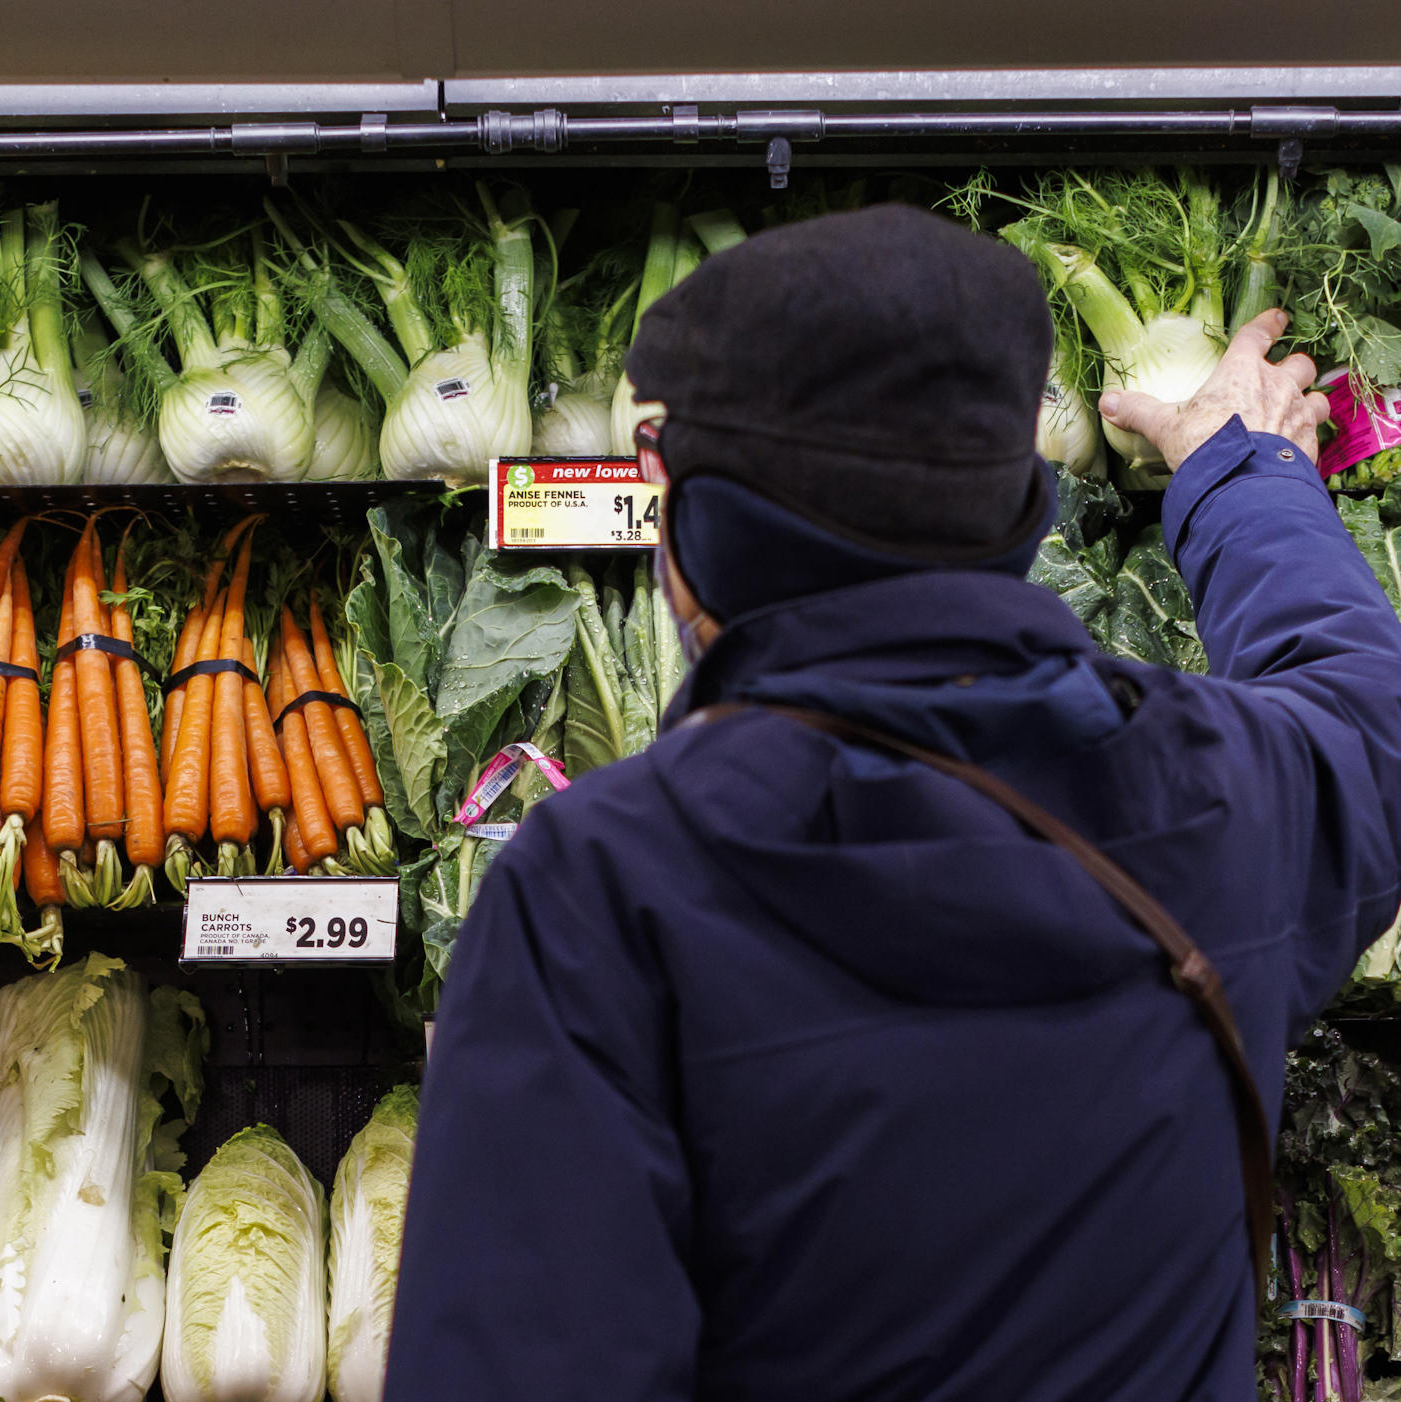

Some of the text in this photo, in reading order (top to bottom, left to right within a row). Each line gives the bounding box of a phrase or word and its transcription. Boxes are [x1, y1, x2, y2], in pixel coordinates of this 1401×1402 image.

[552, 464, 640, 478] new lowe
[509, 491, 586, 499] ANISE FENNEL
[611, 531, 641, 541] $3.28
[202, 914, 239, 922] BUNCH
[201, 923, 252, 932] CARROTS
[286, 916, 368, 948] $2.99
